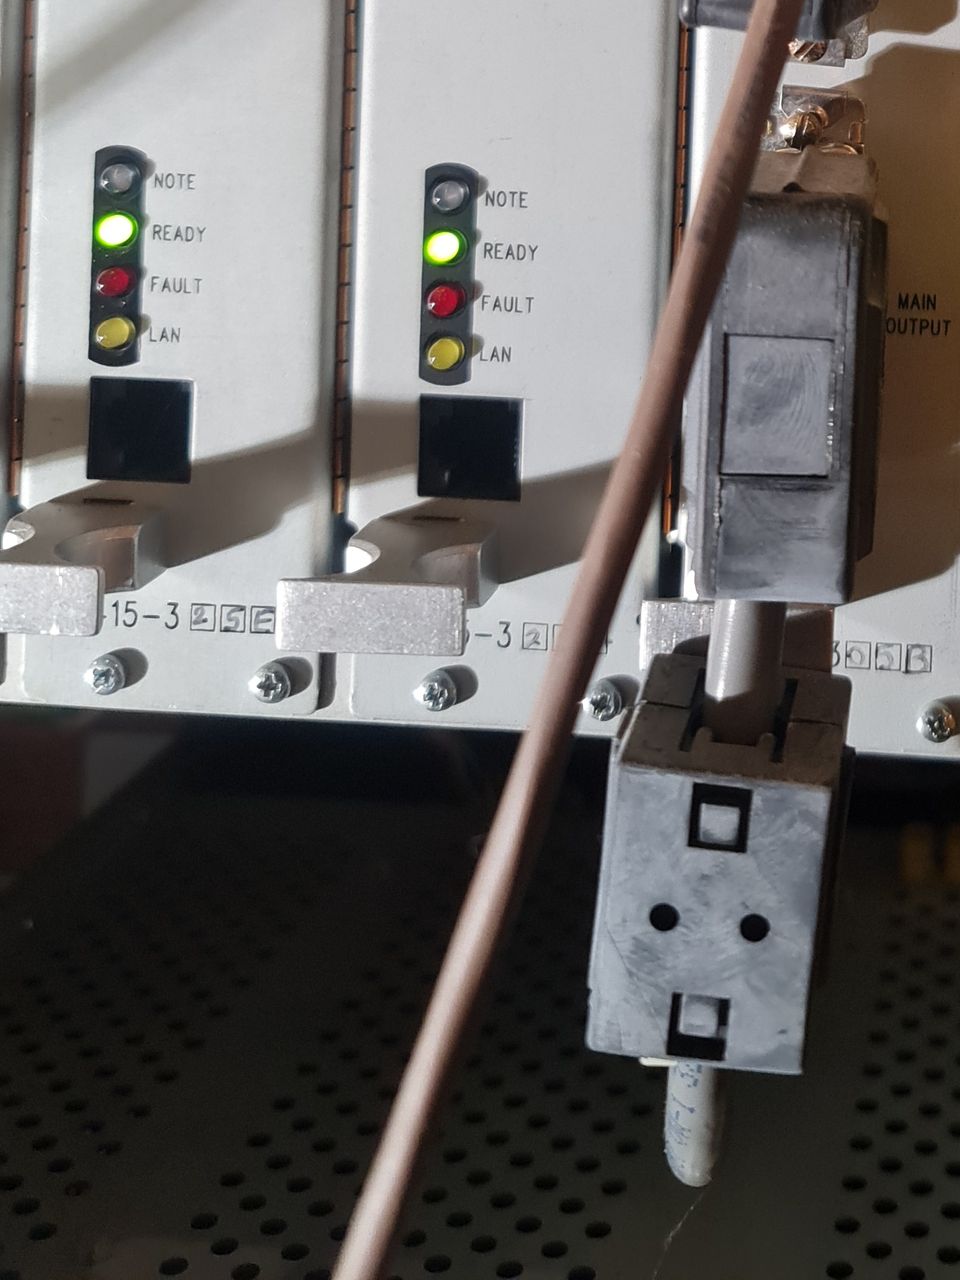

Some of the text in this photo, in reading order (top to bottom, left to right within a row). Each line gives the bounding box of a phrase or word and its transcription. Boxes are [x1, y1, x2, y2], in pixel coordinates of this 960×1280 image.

[153, 172, 196, 191] NOTE
[485, 191, 528, 209] NOTE
[152, 224, 206, 243] READY
[483, 243, 539, 262] READY
[149, 276, 203, 295] FAULT
[481, 295, 535, 314] FAULT
[897, 293, 937, 312] MAIN
[148, 327, 181, 344] LAN
[886, 317, 951, 337] OUTPUT
[480, 347, 512, 363] LAN
[103, 600, 180, 630] 15-3
